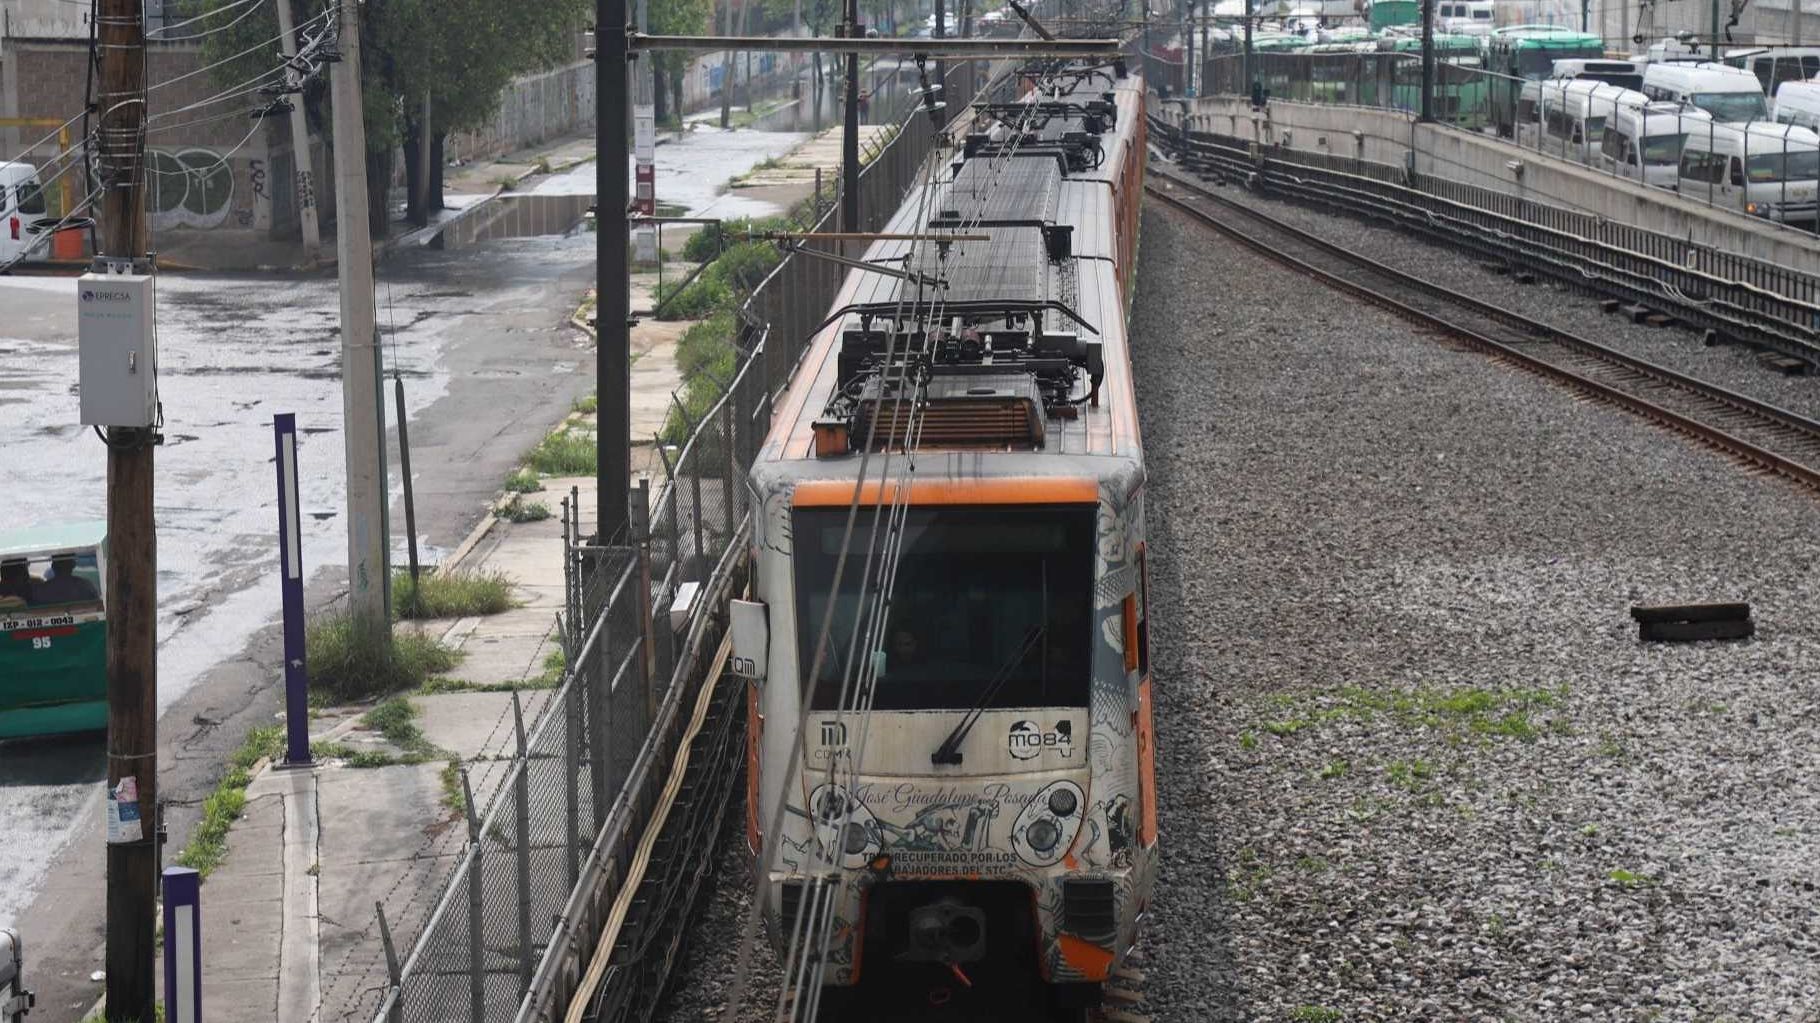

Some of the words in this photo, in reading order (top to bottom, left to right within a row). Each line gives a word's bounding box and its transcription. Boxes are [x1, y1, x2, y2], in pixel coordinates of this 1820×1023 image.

[32, 636, 52, 649] 95
[894, 852, 968, 863] RECUPERADO
[971, 852, 993, 863] POR
[996, 852, 1017, 863] LOS
[962, 865, 982, 876] DEL
